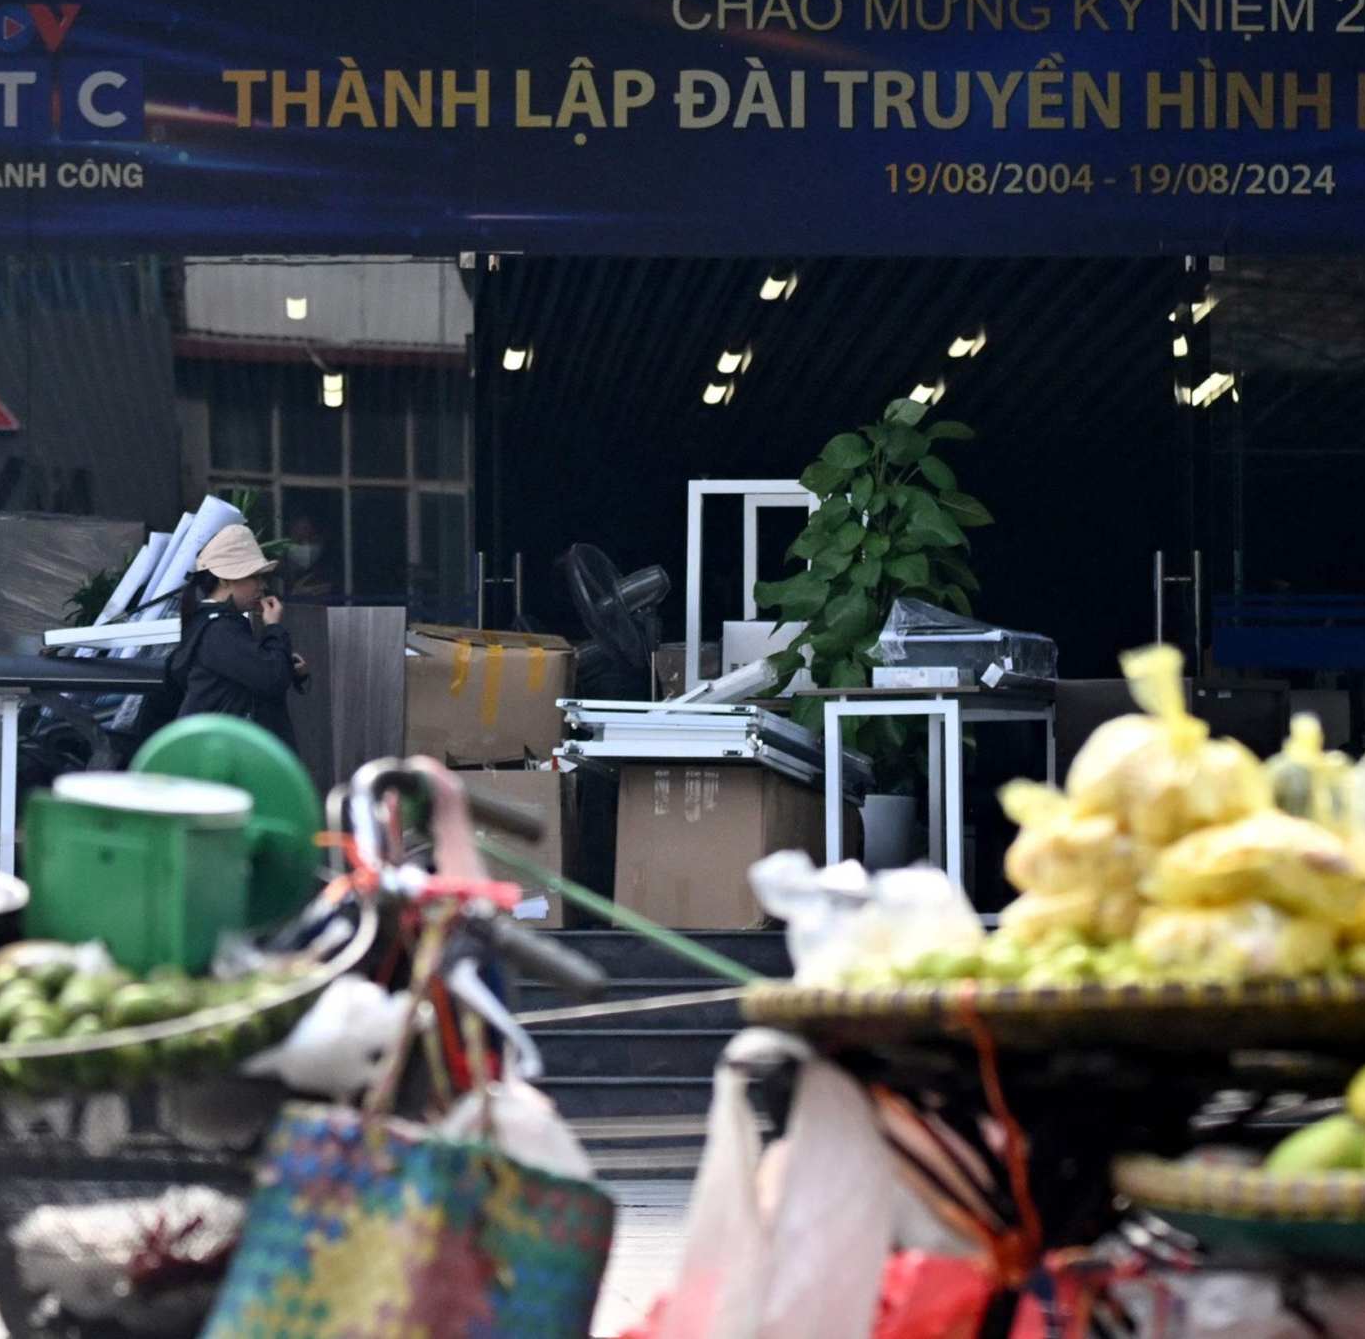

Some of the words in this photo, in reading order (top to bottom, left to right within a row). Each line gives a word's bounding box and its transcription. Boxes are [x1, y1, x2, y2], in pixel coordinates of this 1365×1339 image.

[222, 56, 490, 130] THÀNH
[515, 56, 656, 147] LẬP
[673, 56, 806, 130] ĐÀI
[823, 52, 1122, 131] TRUYỀN
[1145, 56, 1333, 132] HÌNH
[57, 157, 144, 189] CÔNG
[884, 163, 1095, 197] 19/08/2004
[1131, 163, 1336, 197] 19/08/2024
